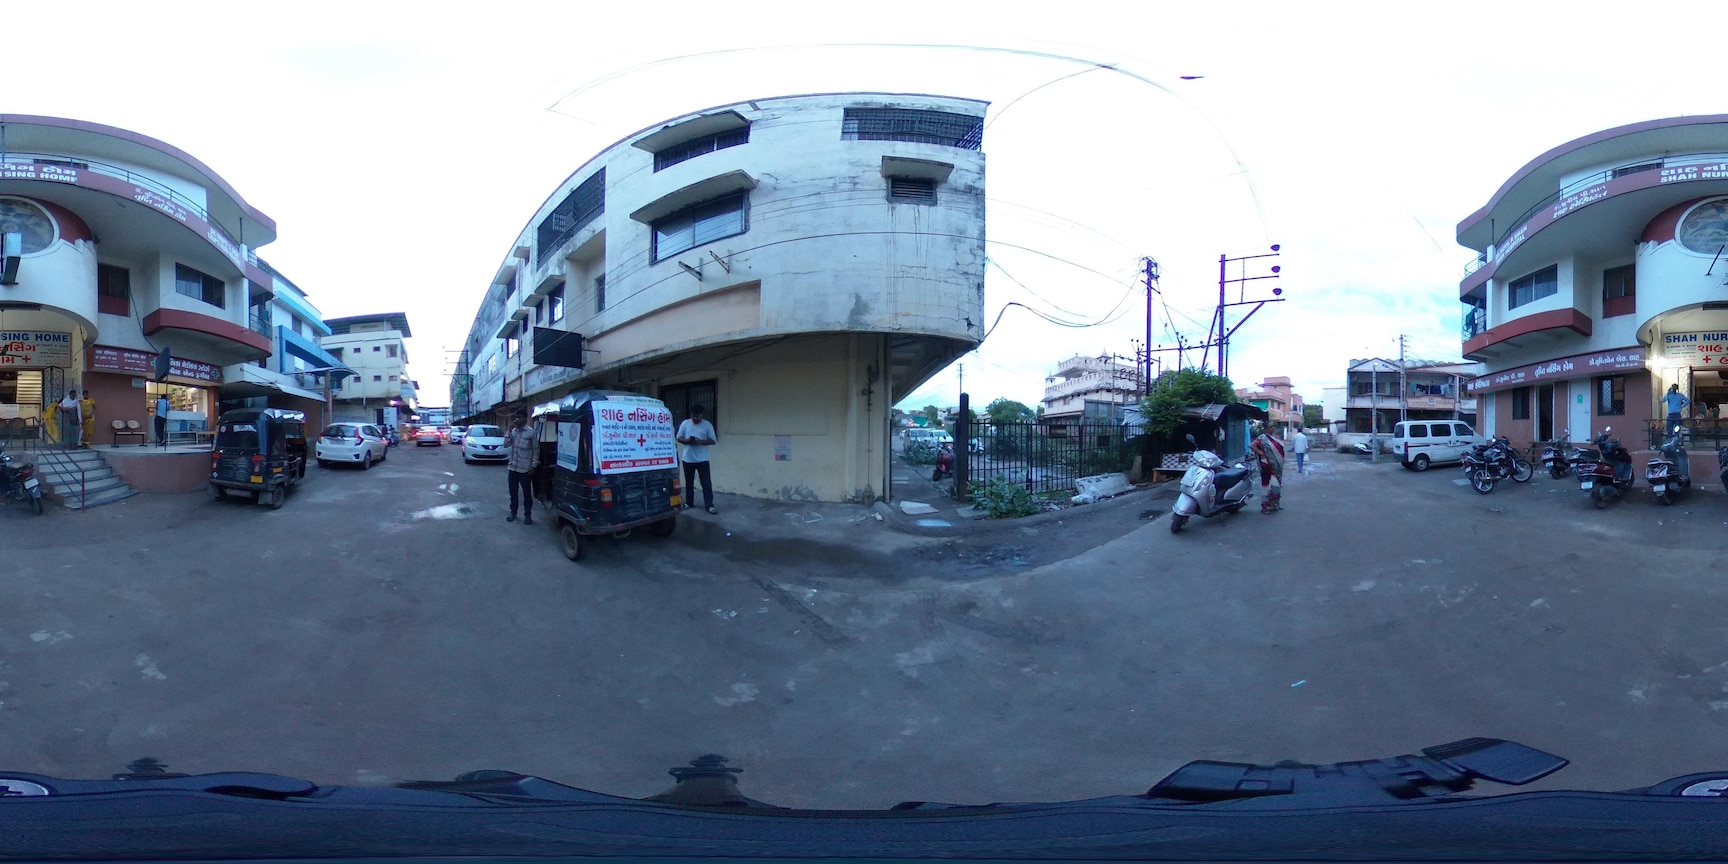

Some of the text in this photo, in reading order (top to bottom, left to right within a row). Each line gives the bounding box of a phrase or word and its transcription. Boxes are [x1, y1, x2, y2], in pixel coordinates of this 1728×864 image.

[40, 173, 78, 183] HOME
[1661, 173, 1697, 183] SHAH
[35, 333, 69, 343] HOME
[1665, 334, 1697, 343] SHAH
[1698, 344, 1722, 352] શાહ
[602, 408, 624, 422] શાહ
[628, 407, 655, 422] નર્સિંગ
